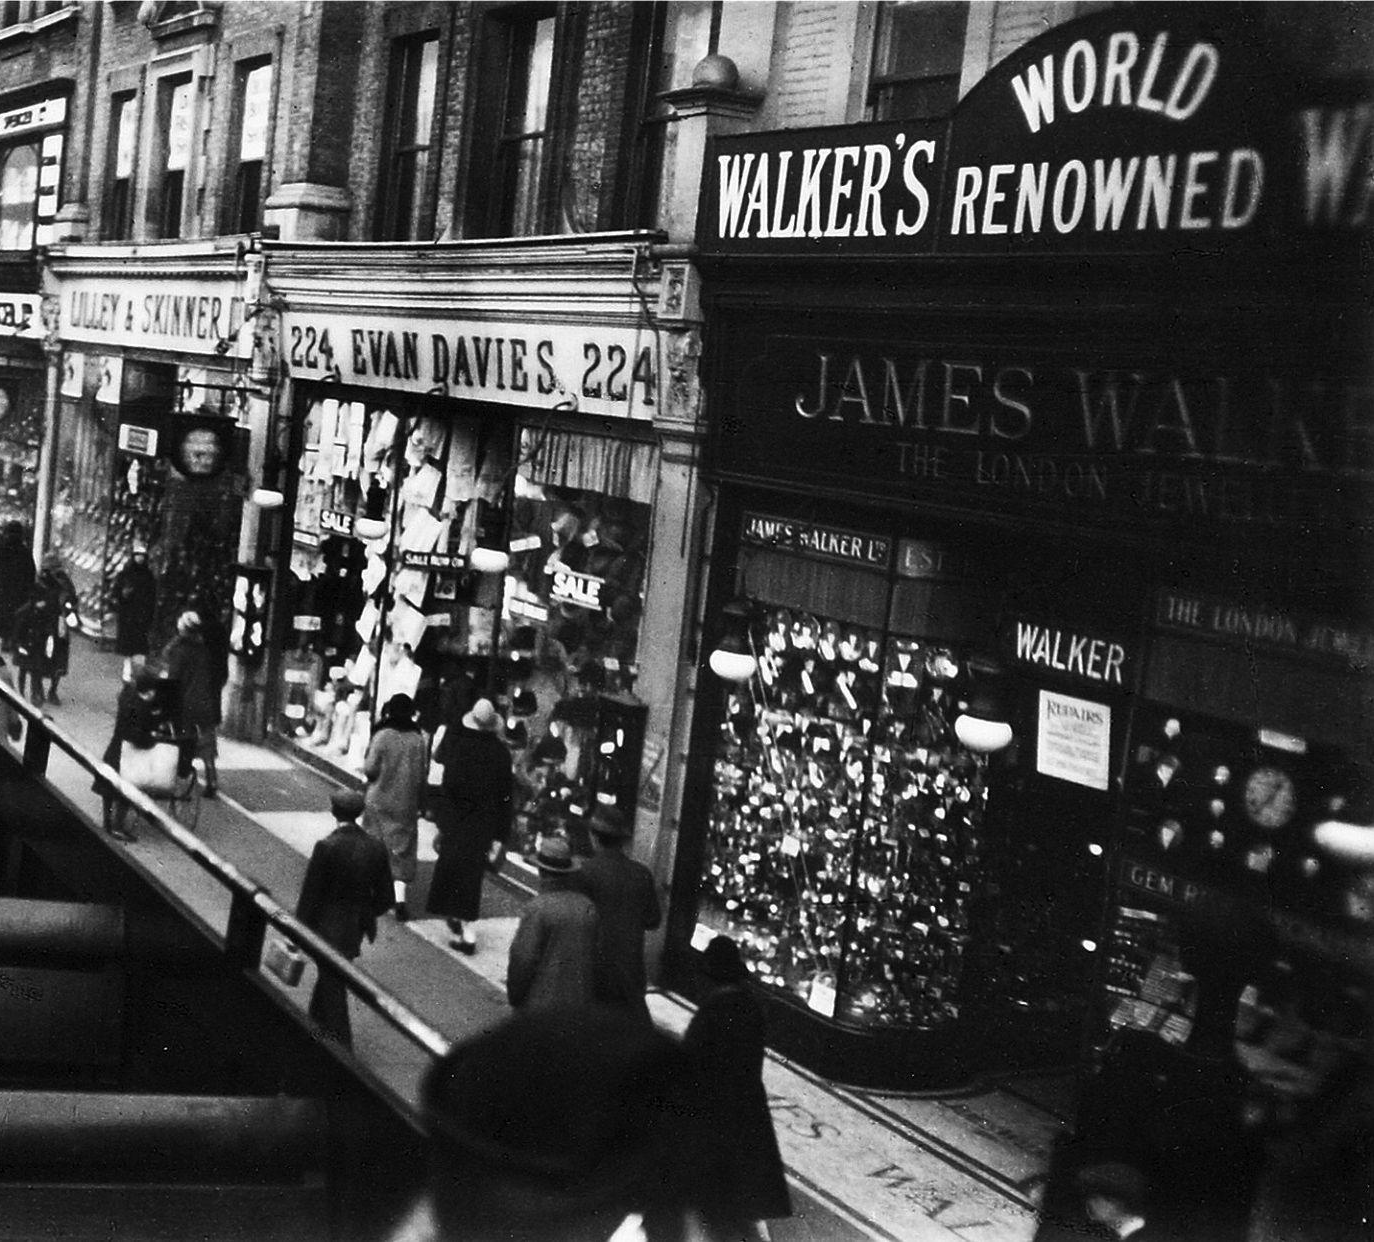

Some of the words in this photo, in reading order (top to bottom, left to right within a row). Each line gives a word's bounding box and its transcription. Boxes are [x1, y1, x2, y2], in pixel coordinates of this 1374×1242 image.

[1011, 31, 1220, 133] WORLD
[717, 133, 936, 239] WALKER'S
[950, 148, 1265, 237] RENOWNED
[69, 290, 121, 331] LILLEY
[141, 294, 222, 341] SKINNER
[290, 325, 334, 372] 224
[350, 328, 419, 381] EVAN
[581, 341, 657, 406] 224
[794, 355, 1035, 440] JAMES
[897, 442, 947, 479] THE
[977, 451, 1108, 501] LONDON
[321, 510, 352, 535] SALE
[745, 517, 793, 540] JAMES
[799, 527, 863, 558] WALKER
[405, 552, 428, 566] SALE
[552, 571, 601, 606] SALE
[1016, 621, 1126, 685] WALKER
